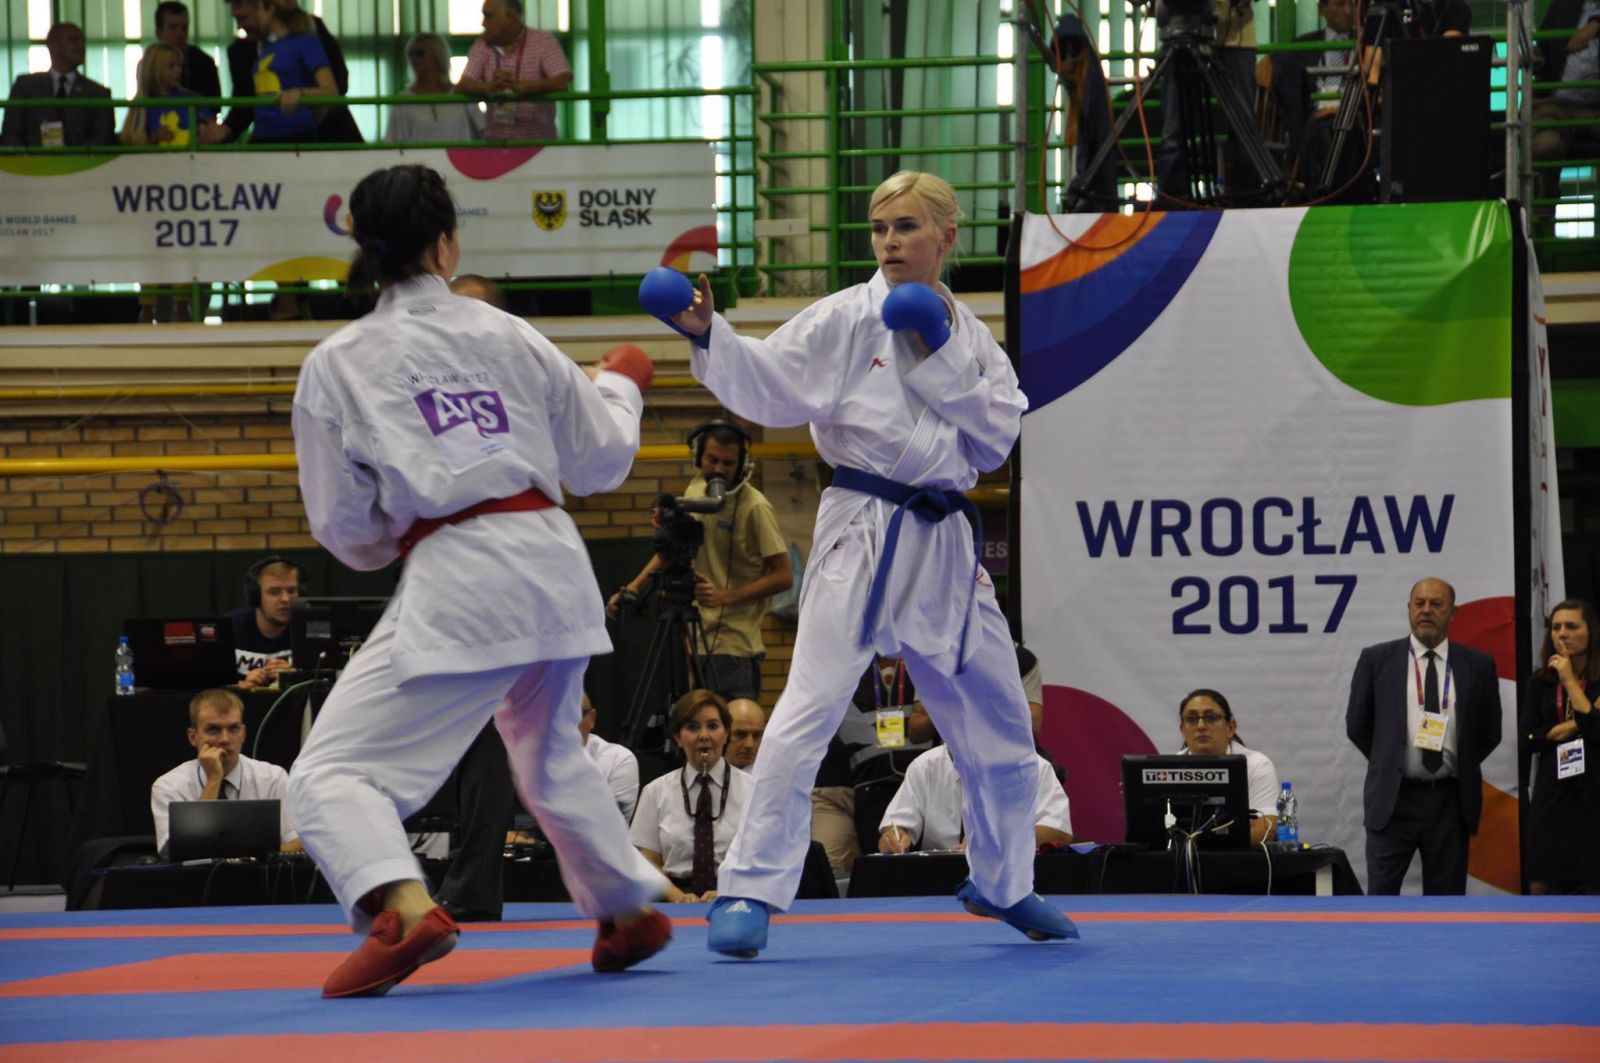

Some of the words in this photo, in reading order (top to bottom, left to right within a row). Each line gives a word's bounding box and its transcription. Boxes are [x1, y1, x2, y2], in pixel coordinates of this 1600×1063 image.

[112, 183, 282, 213] WROCŁAW
[579, 188, 656, 208] DOLNY
[5, 214, 41, 225] WORLD
[43, 213, 77, 224] GAMES
[579, 204, 653, 229] ŚLĄSK
[155, 219, 239, 248] 2017
[1075, 494, 1455, 558] WROCŁAW
[1170, 575, 1358, 634] 2017
[1168, 771, 1226, 781] TISSOT
